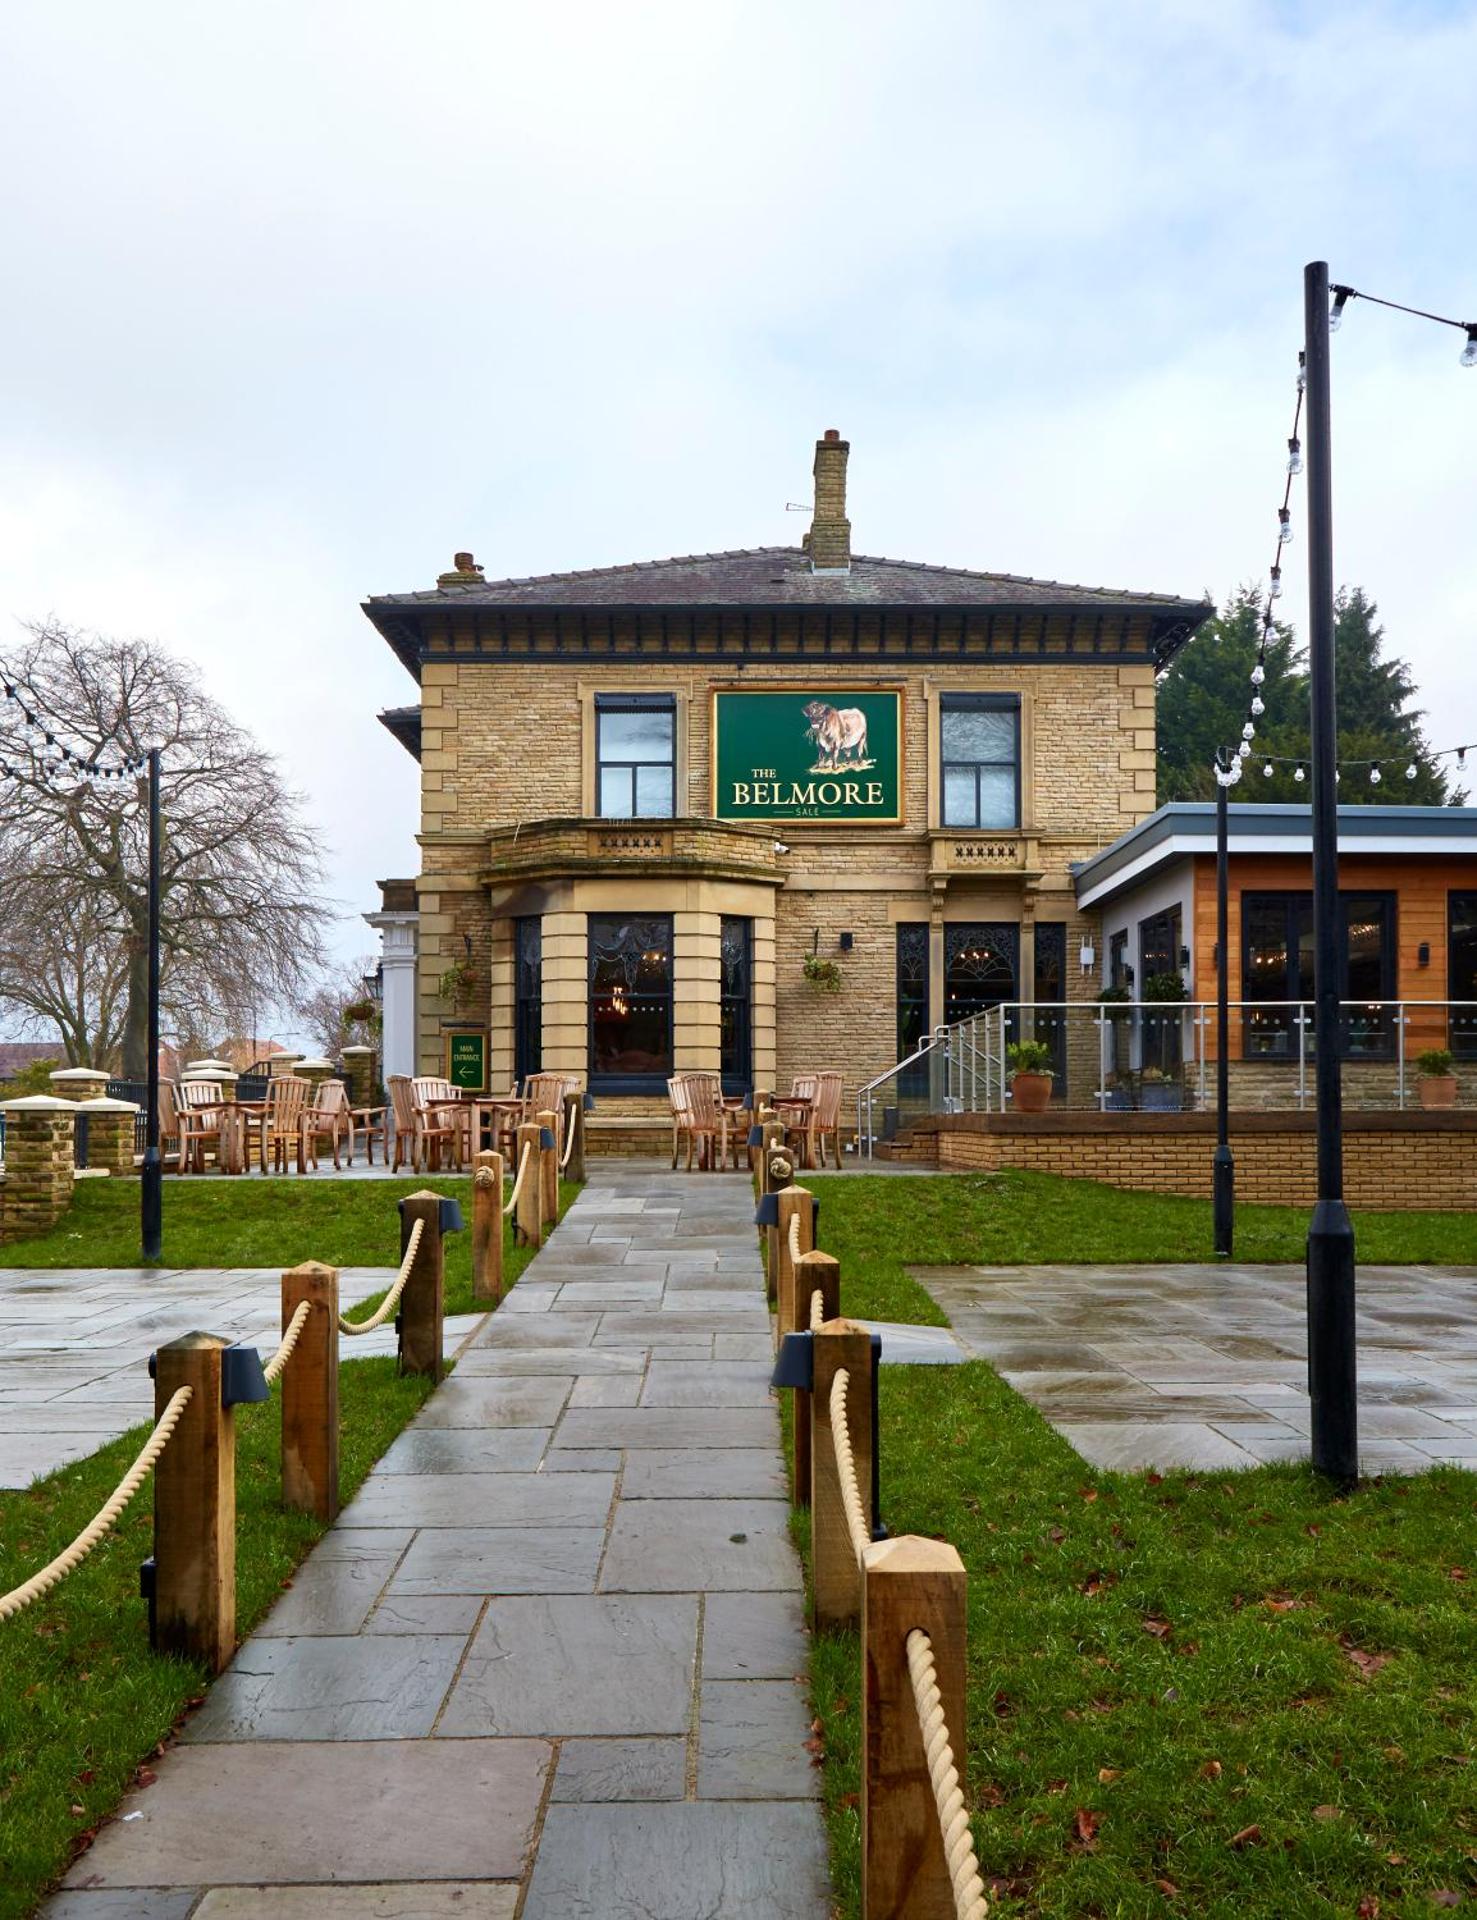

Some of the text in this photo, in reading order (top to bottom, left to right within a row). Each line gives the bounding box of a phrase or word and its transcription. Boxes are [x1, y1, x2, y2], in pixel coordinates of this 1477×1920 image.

[751, 768, 776, 778] THE
[732, 782, 884, 805] BELMORE
[795, 808, 819, 816] SALE
